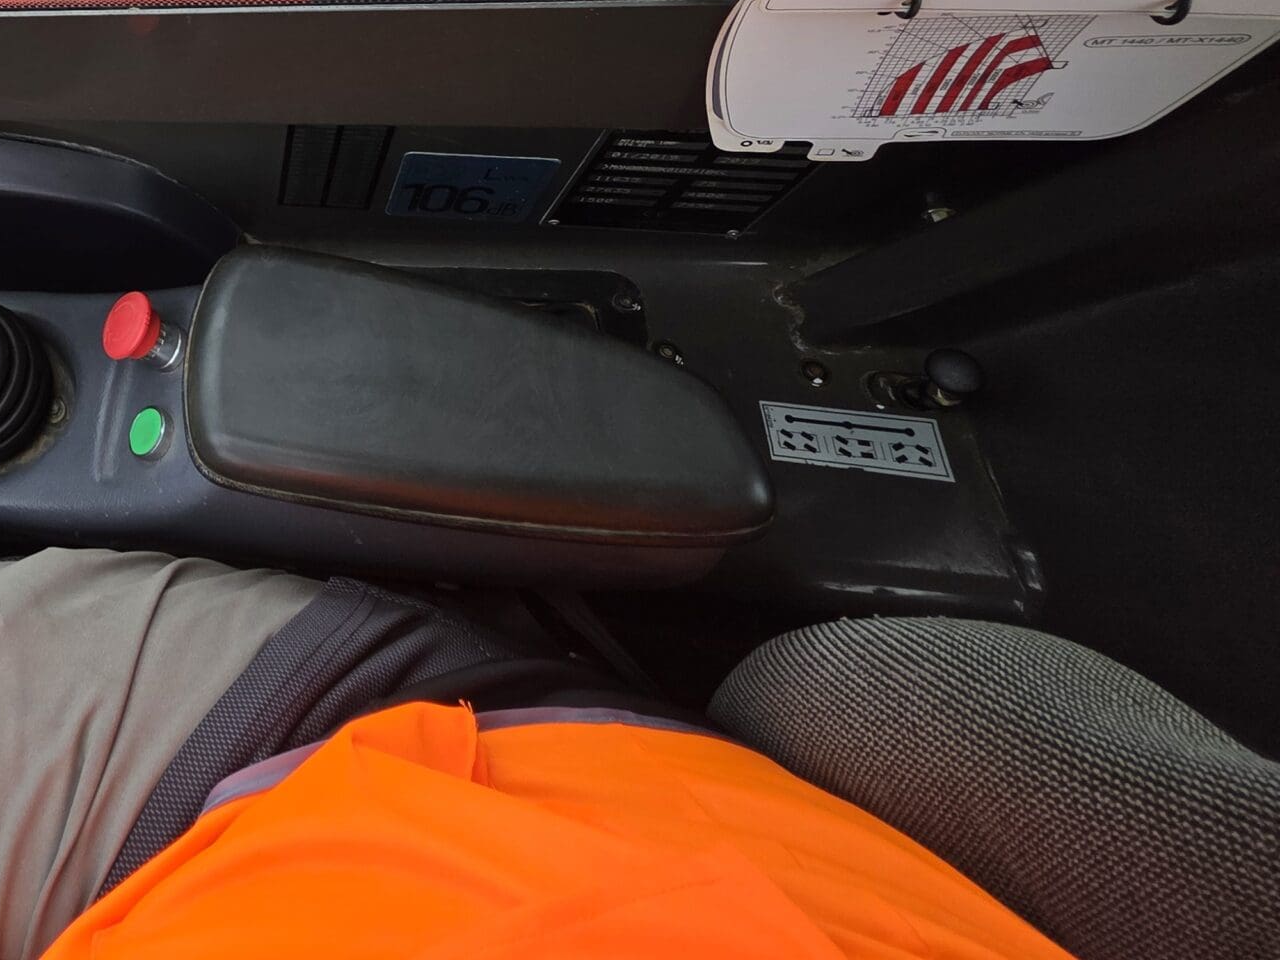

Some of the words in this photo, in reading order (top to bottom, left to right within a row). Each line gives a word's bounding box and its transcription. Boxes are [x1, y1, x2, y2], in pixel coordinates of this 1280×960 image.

[1091, 38, 1115, 46] MT
[1121, 37, 1153, 46] 1440
[402, 182, 495, 215] 106
